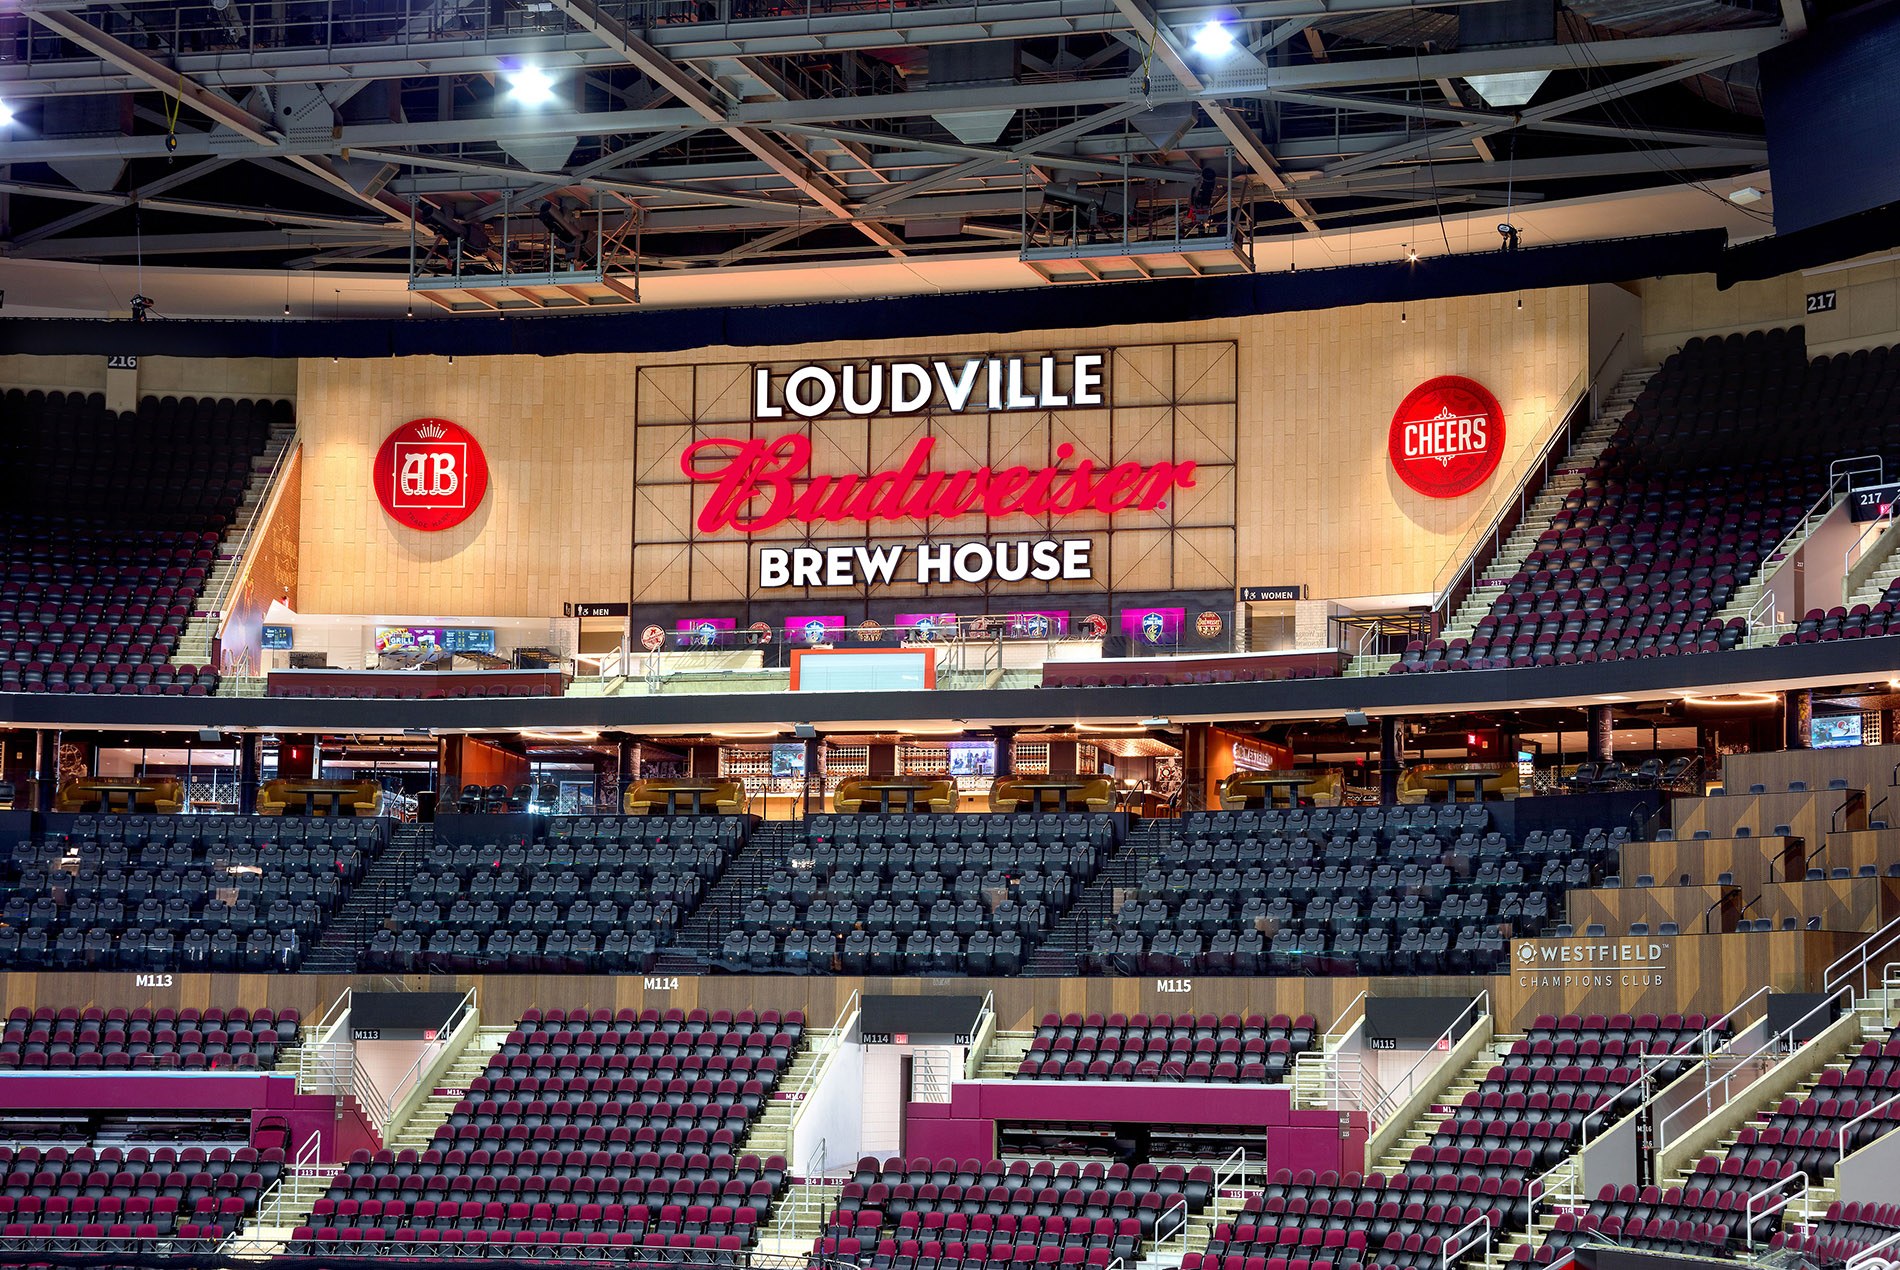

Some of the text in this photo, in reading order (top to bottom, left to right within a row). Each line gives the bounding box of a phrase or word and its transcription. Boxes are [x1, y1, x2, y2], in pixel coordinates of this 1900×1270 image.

[1807, 292, 1835, 311] 217
[108, 355, 137, 368] 216
[755, 353, 1104, 420] LOUDVILLE
[1404, 417, 1487, 456] CHEERS
[400, 451, 459, 496] AB
[680, 433, 1197, 533] Budweiser
[1859, 491, 1882, 506] 217
[760, 539, 1093, 588] BREW HOUSE
[1260, 591, 1294, 600] WOMEN
[592, 608, 610, 616] MEN
[1540, 944, 1662, 962] WESTFIELD
[136, 974, 173, 987] M113
[644, 977, 679, 990] M114
[1157, 979, 1192, 993] M115
[1519, 975, 1663, 987] CHAMPIONS CLUB
[354, 1030, 379, 1040] M113
[863, 1034, 889, 1043] M114
[1372, 1039, 1395, 1049] M115
[1230, 1190, 1241, 1198] 115
